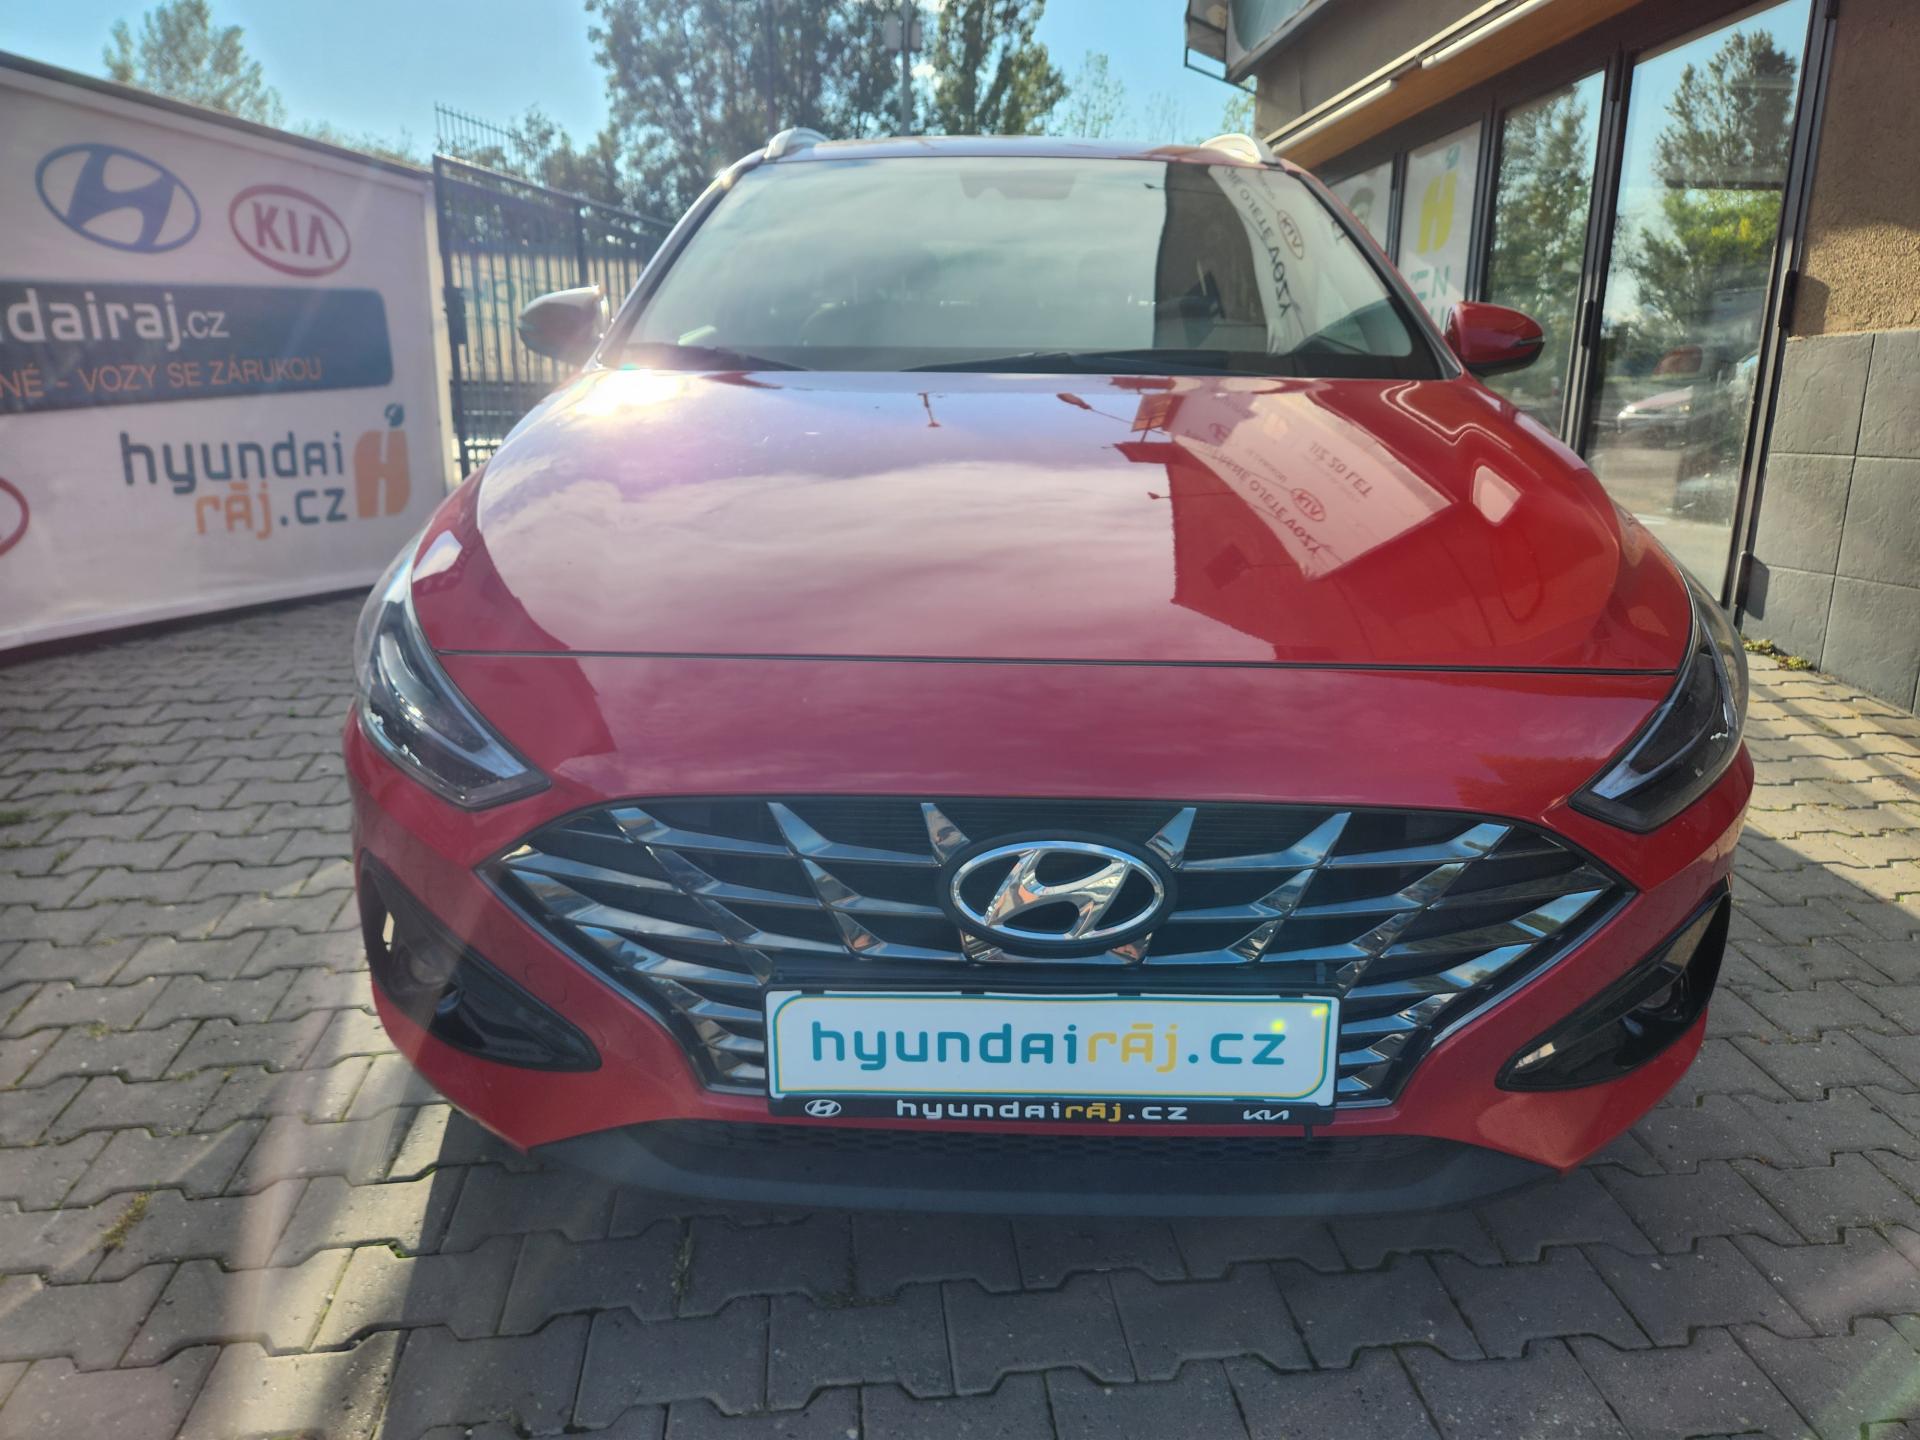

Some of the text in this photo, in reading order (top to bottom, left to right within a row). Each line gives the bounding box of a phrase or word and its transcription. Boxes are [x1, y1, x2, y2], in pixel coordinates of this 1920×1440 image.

[252, 202, 334, 260] KIA
[0, 287, 229, 352] dairaj.cz
[77, 363, 157, 393] VOZY
[167, 364, 201, 389] SE
[208, 354, 323, 386] ZÁRUKOU
[120, 430, 345, 495] hyundai
